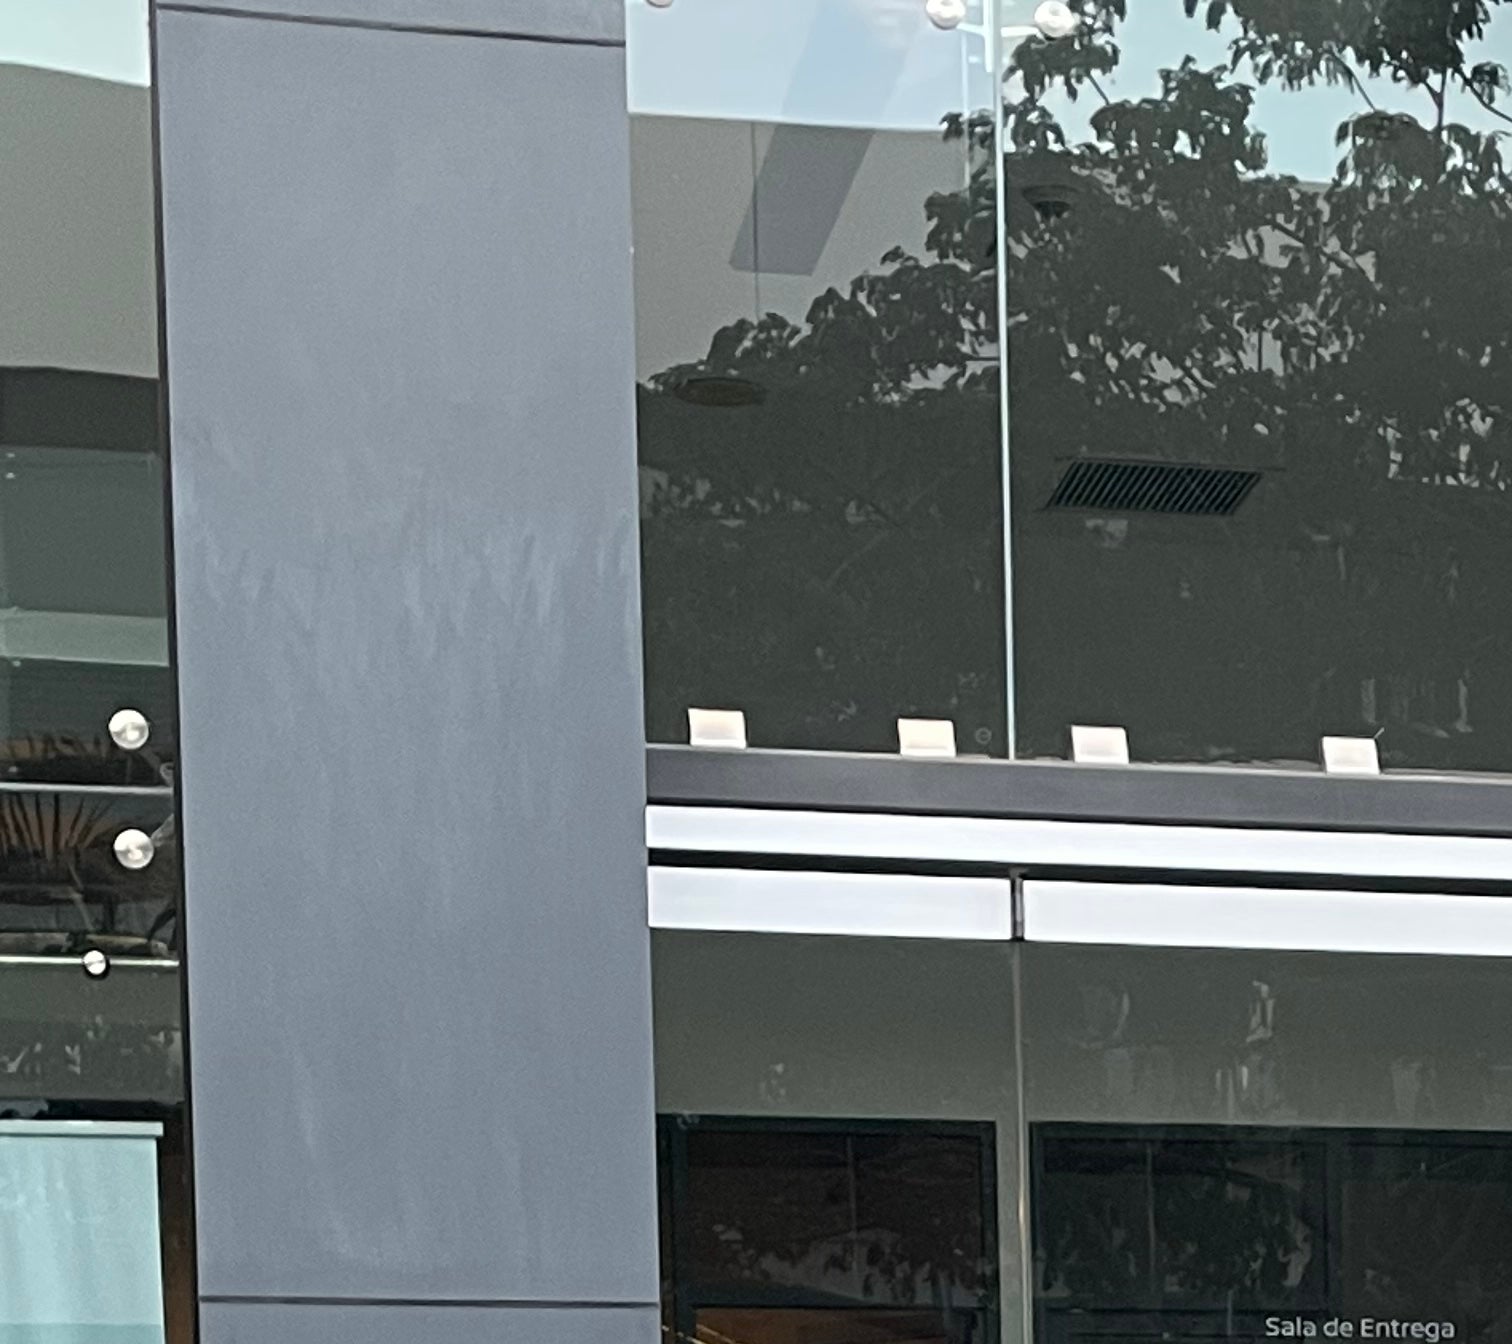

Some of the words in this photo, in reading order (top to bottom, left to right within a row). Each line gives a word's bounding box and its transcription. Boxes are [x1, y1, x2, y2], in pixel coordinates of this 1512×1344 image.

[1265, 1316, 1317, 1337] Sala
[1322, 1317, 1354, 1338] de
[1360, 1318, 1456, 1343] Entrega
